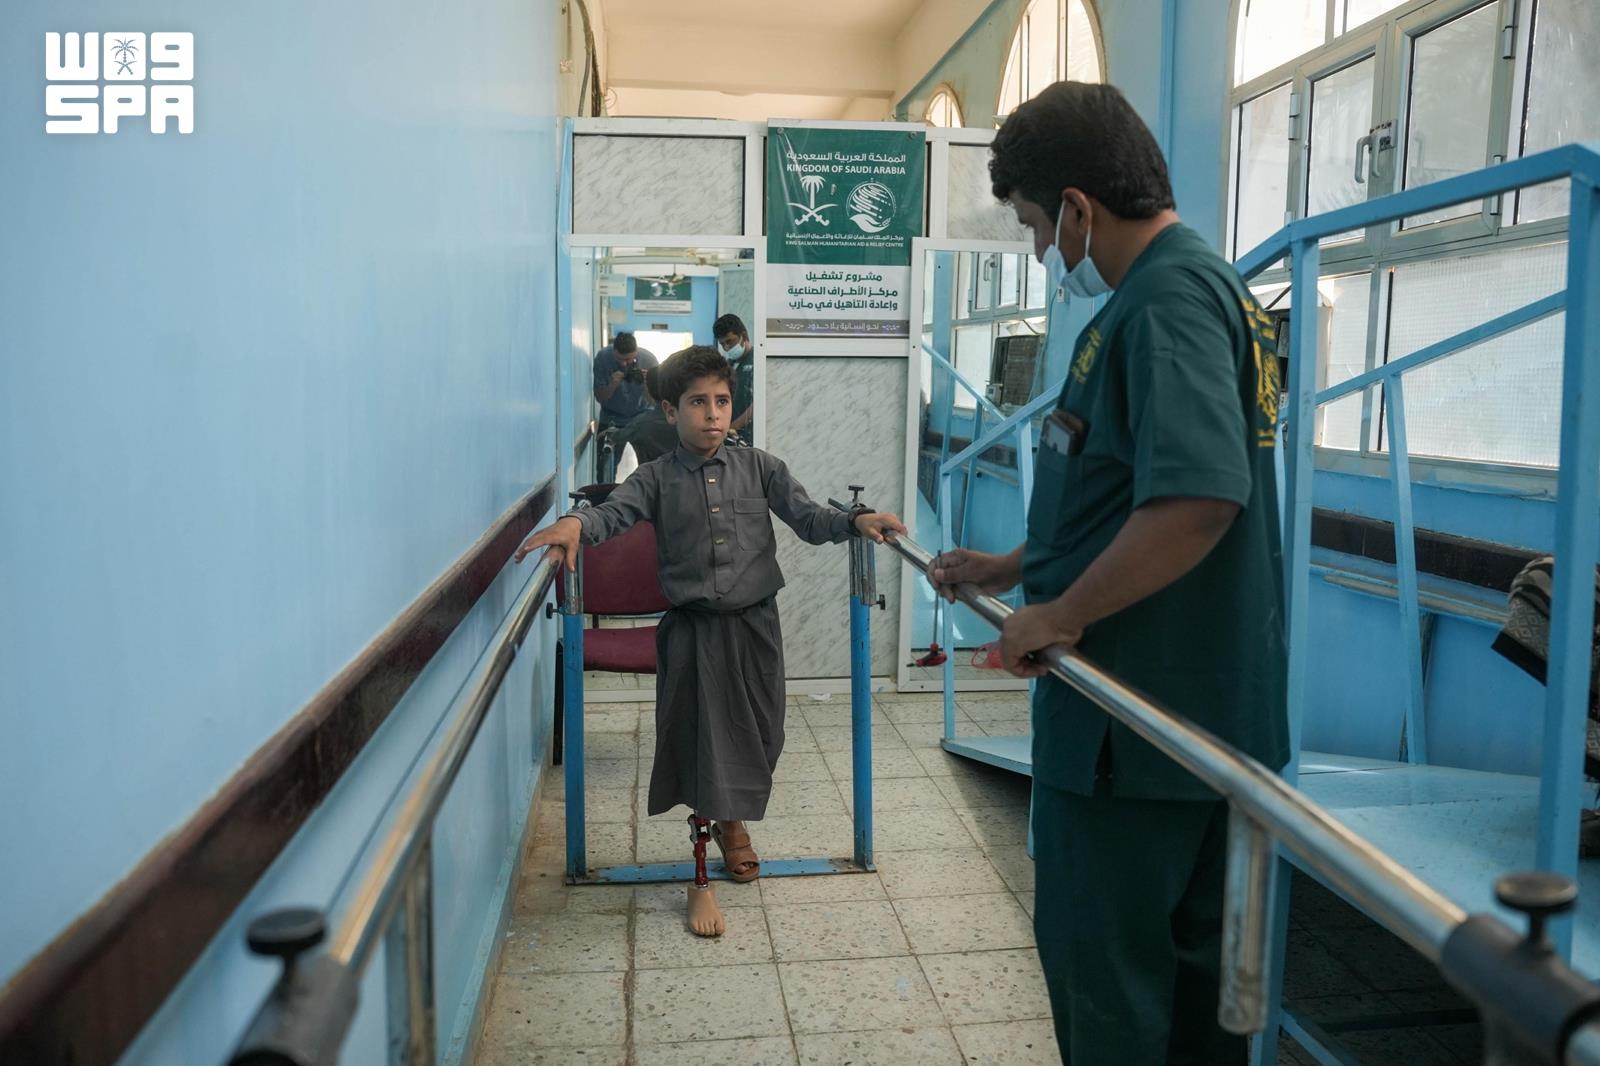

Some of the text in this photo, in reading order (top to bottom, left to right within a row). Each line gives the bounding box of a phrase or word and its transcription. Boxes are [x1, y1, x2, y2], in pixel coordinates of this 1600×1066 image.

[786, 151, 906, 162] المملكة العربية السعودية
[786, 164, 906, 174] KINGDOM OF SAUDI ARABIA
[806, 271, 882, 282] مشروع تشغيل
[788, 286, 898, 297] مركز الأطراف الصناعية
[815, 300, 832, 311] في
[834, 300, 867, 310] التأهيل
[869, 300, 898, 311] وإعادة
[866, 322, 879, 330] نحو
